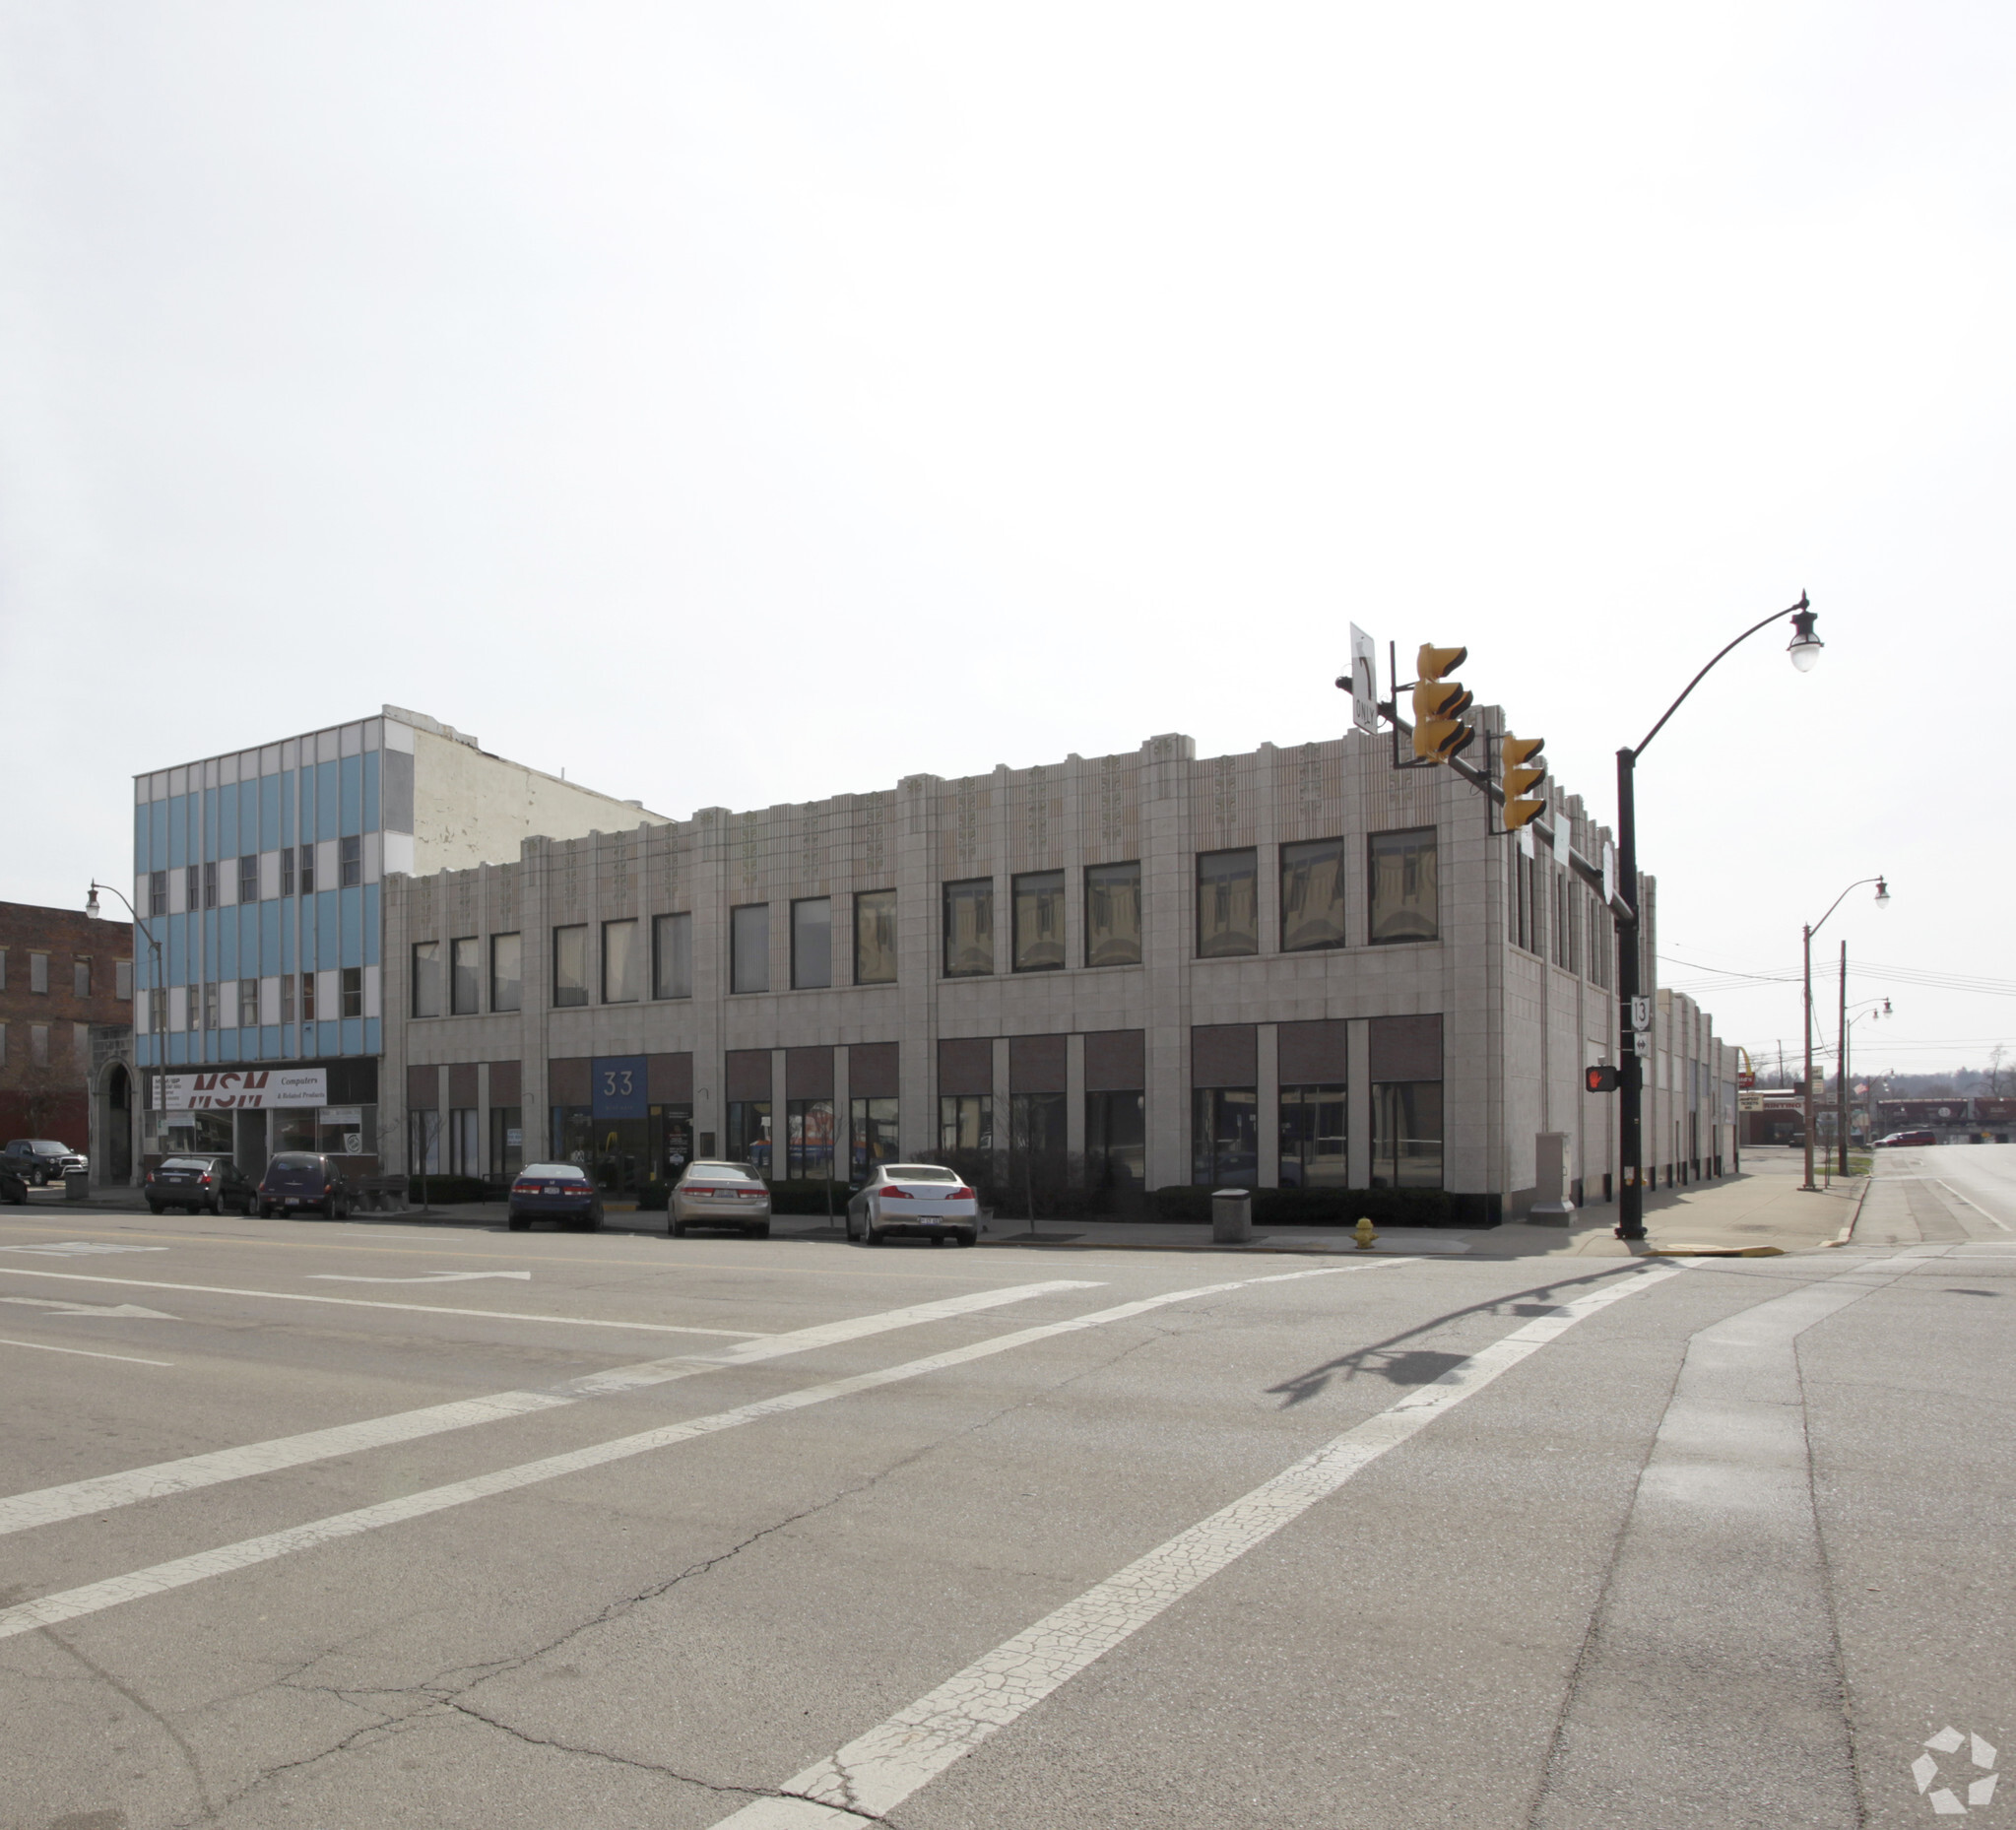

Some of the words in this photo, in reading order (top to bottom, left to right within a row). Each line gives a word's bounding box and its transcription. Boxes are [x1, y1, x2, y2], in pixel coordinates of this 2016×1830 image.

[1356, 698, 1375, 727] ONLY
[1635, 1002, 1647, 1022] 13
[187, 1071, 270, 1109] MSM
[281, 1077, 318, 1086] Computers
[604, 1070, 633, 1096] 33
